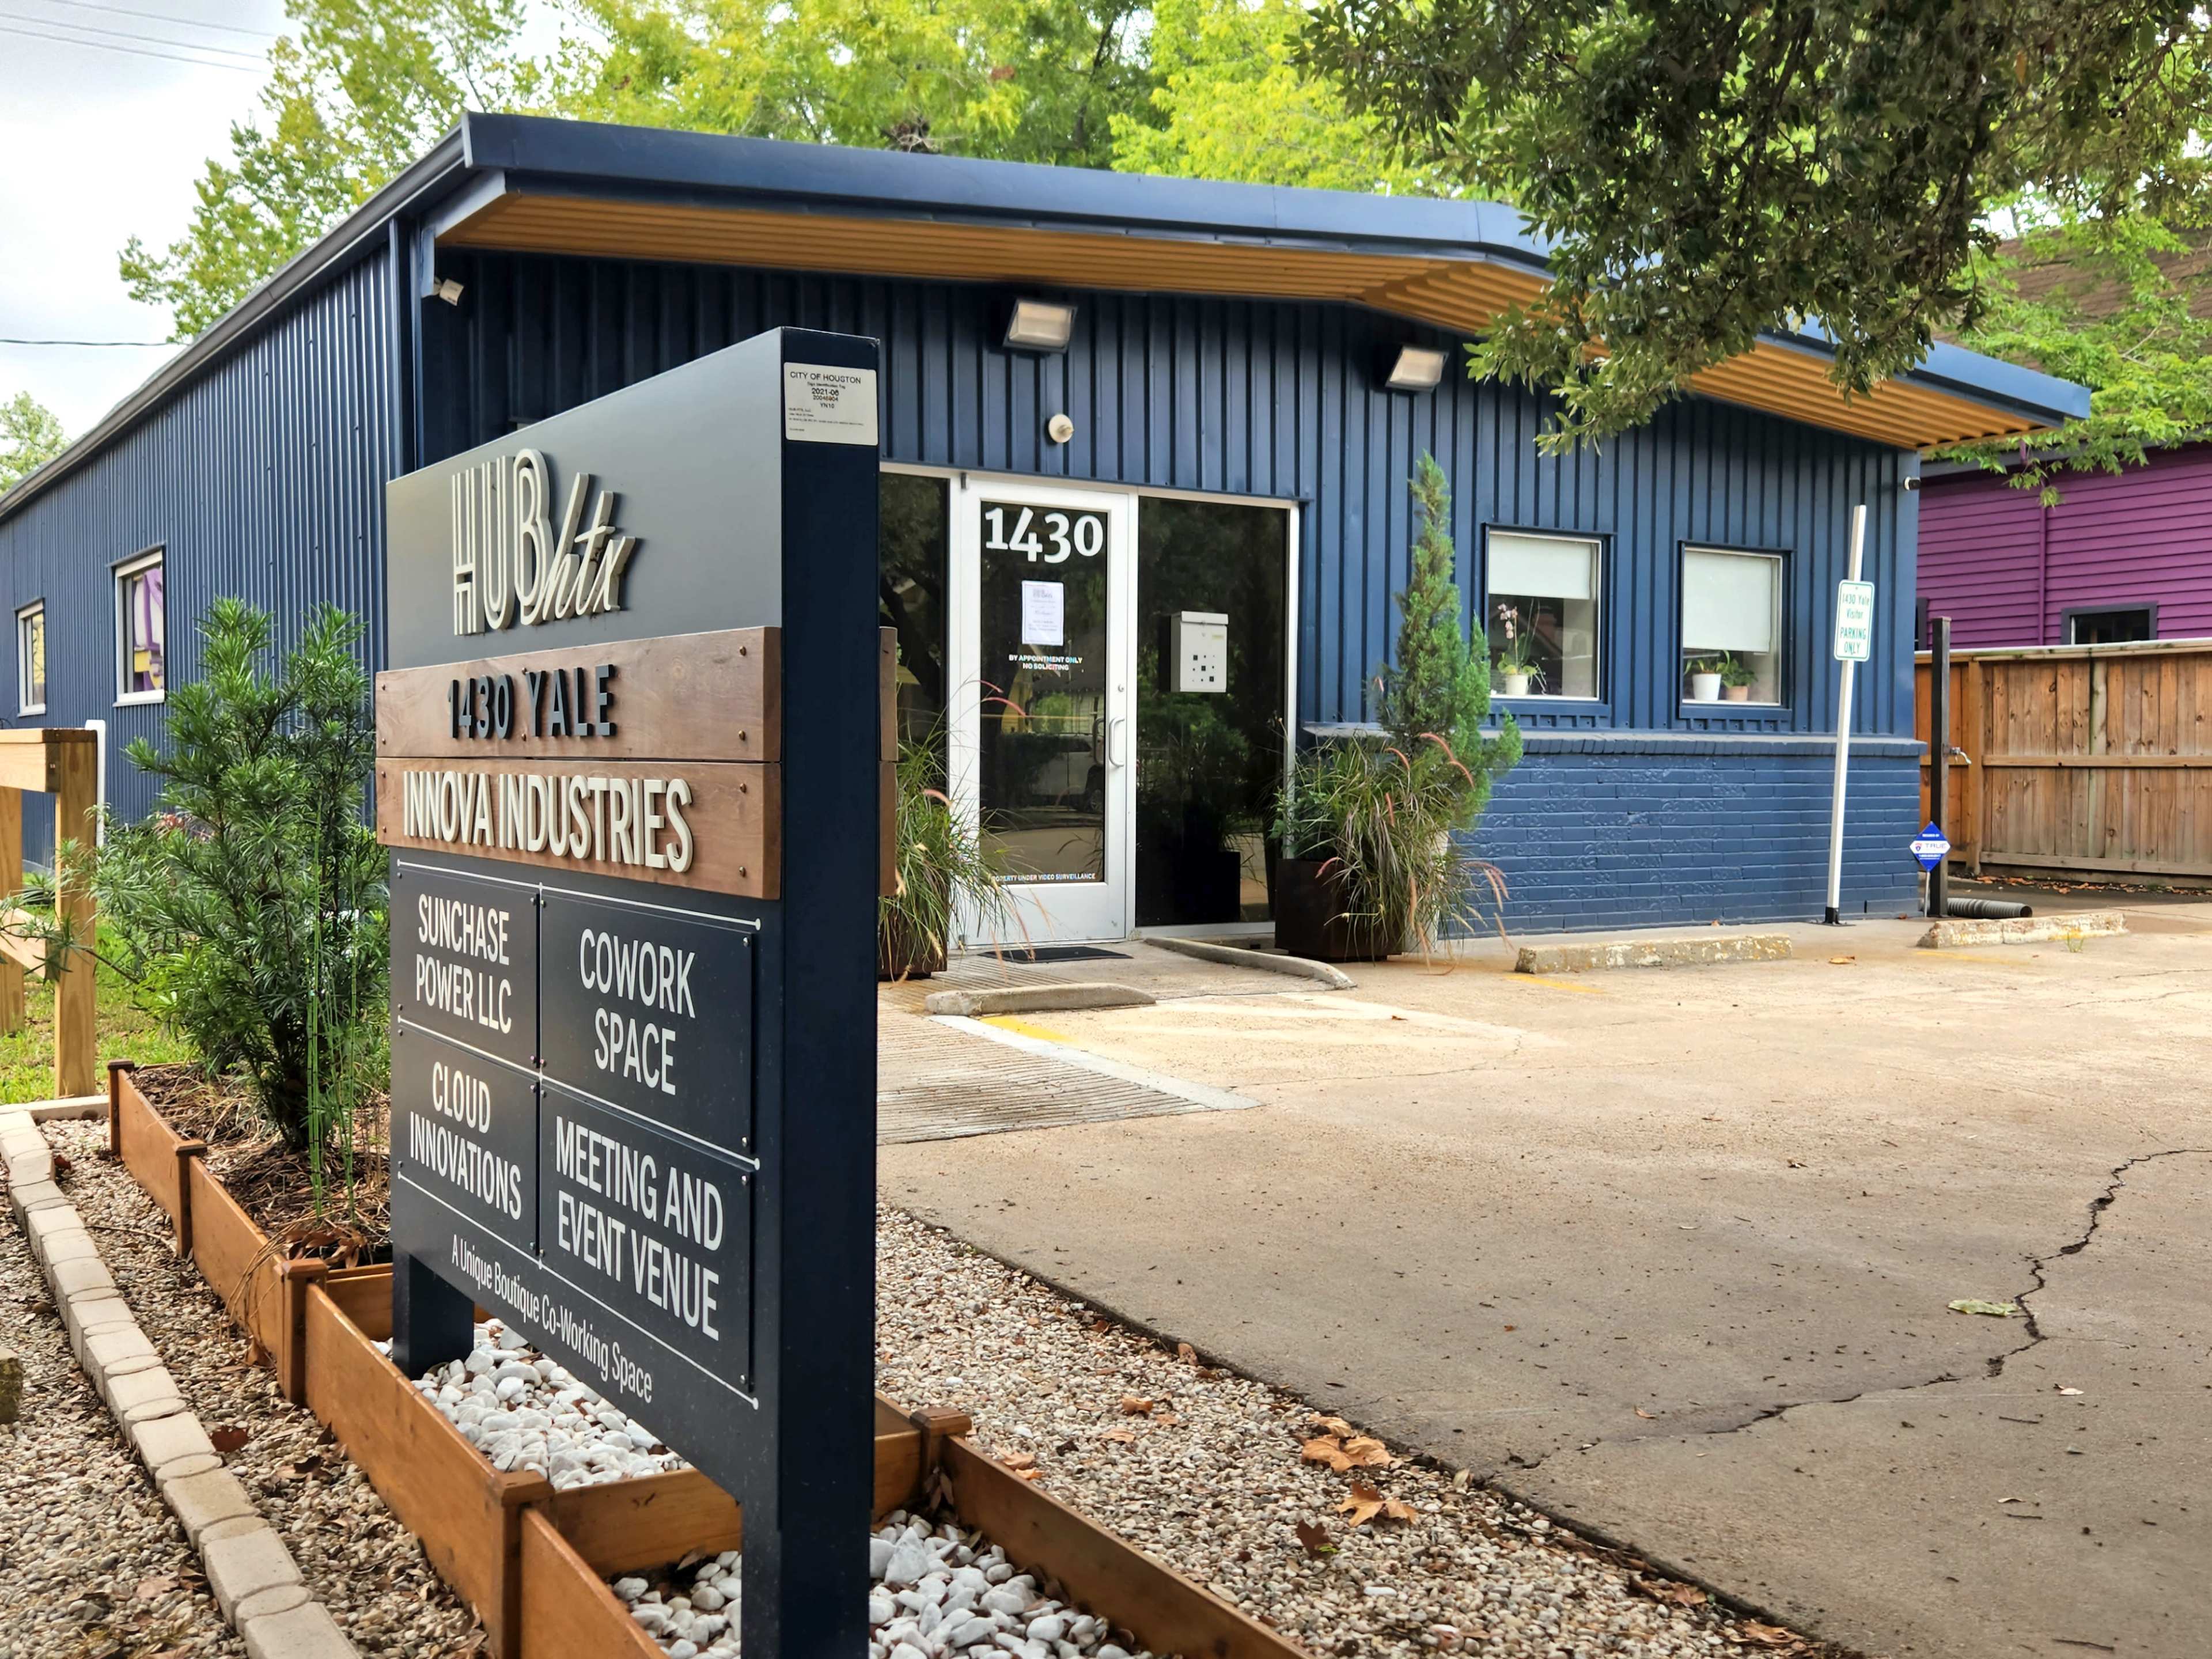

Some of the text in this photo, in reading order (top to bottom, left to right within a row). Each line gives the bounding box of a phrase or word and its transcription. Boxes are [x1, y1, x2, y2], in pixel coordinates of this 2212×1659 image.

[823, 374, 861, 384] HOUSTON
[985, 506, 1103, 563] 1430
[1840, 627, 1866, 640] PARKING
[1842, 594, 1870, 605] 1430 Yale
[1846, 608, 1863, 619] Visitor
[1018, 654, 1065, 663] APPOINTMENT
[1844, 641, 1861, 655] ONLY
[447, 664, 616, 740] 1430 YALE
[403, 770, 693, 873] INNOVA INDUSTRIES
[418, 893, 510, 966] SUNCHASE
[416, 953, 512, 1034] POWER LLC
[579, 928, 696, 1018] COWORK
[594, 1007, 676, 1096] SPACE
[432, 1061, 491, 1134] CLOUD
[410, 1111, 521, 1220] INNOVATIONS
[556, 1116, 724, 1251] MEETING AND
[558, 1190, 719, 1341] EVENT VENUE
[452, 1234, 652, 1403] A Unique Boutique Co-Working Space
